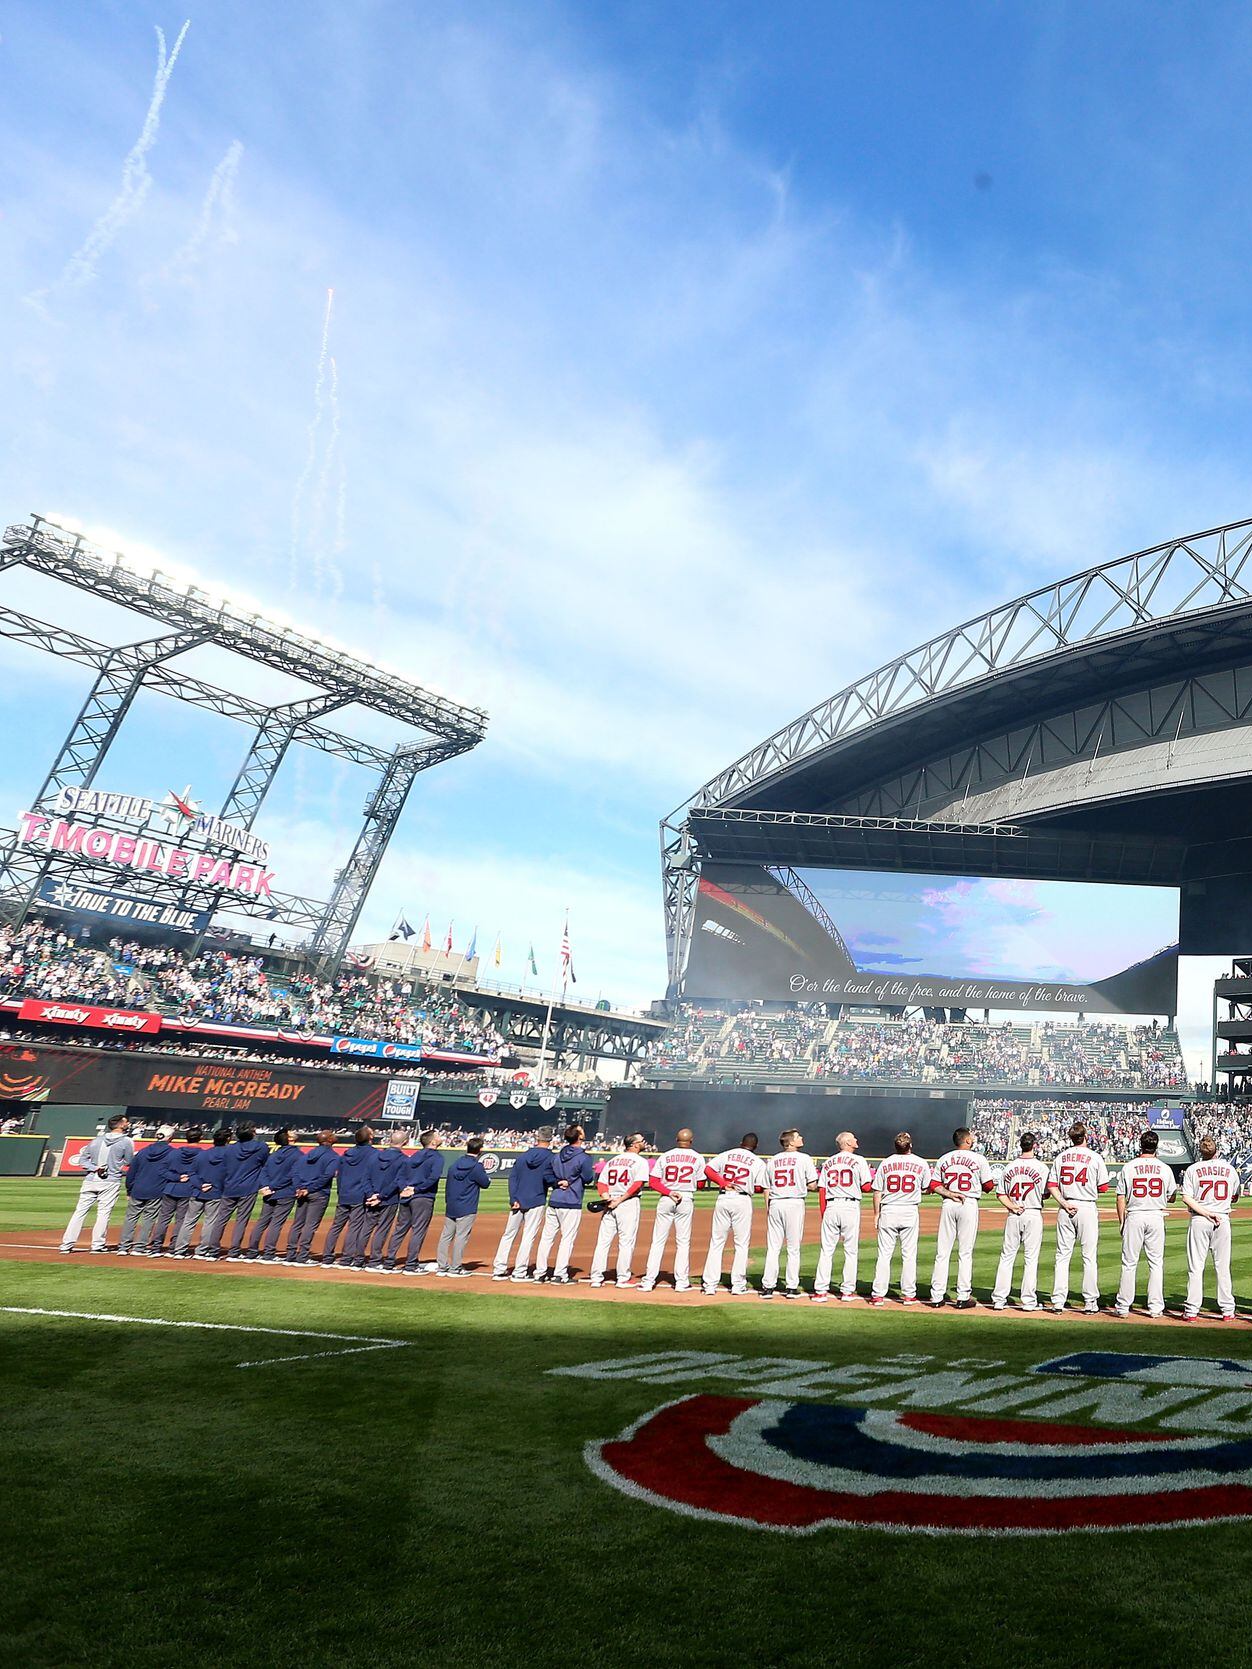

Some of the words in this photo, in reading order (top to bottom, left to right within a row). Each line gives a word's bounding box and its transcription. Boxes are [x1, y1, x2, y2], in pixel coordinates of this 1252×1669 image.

[60, 786, 150, 820] SEATTLE
[195, 815, 269, 861] MARINERS
[22, 811, 189, 877] T-MOBILE
[192, 852, 276, 897] PARK
[70, 886, 110, 913] TRUE
[110, 897, 132, 917] TO
[133, 902, 162, 923] THE
[161, 905, 199, 929] BLUE
[789, 974, 819, 992] O'er
[822, 979, 840, 992] the
[843, 980, 874, 993] land
[874, 980, 890, 1001] of
[890, 982, 908, 996] the
[938, 984, 965, 998] and
[965, 985, 983, 998] the
[984, 986, 1016, 1000] home
[1018, 987, 1034, 1007] of
[1034, 988, 1052, 1001] the
[1054, 988, 1088, 1003] brave.
[40, 1005, 91, 1023] xfinity
[101, 1012, 149, 1030] xfinity
[350, 1044, 378, 1054] pepsi
[396, 1048, 420, 1058] pepsi
[194, 1064, 236, 1078] NATIONAL
[237, 1069, 273, 1081] ANTHEM
[147, 1074, 204, 1094] MIKE
[390, 1084, 416, 1096] BUILT
[202, 1096, 231, 1109] PEARL
[230, 1099, 251, 1110] JAM
[514, 1096, 524, 1104] 24
[544, 1098, 552, 1106] 11
[386, 1105, 412, 1115] TOUGH
[665, 1154, 697, 1164] GOODWIN
[727, 1154, 755, 1166] FEBLES
[1061, 1153, 1092, 1165] BREWER
[608, 1169, 630, 1186] 84
[665, 1165, 694, 1183] 82
[722, 1164, 750, 1186] 52
[882, 1162, 923, 1175] BANNISTER
[1004, 1166, 1042, 1184] THORNBURG
[1060, 1166, 1088, 1186] 54
[1134, 1165, 1161, 1175] TRAVIS
[1196, 1166, 1230, 1178] BRASIER
[774, 1169, 796, 1187] 51
[827, 1169, 853, 1187] 30
[887, 1174, 916, 1193] 86
[945, 1173, 972, 1191] 76
[1010, 1182, 1036, 1201] 47
[1132, 1178, 1163, 1198] 59
[1199, 1180, 1228, 1201] 70
